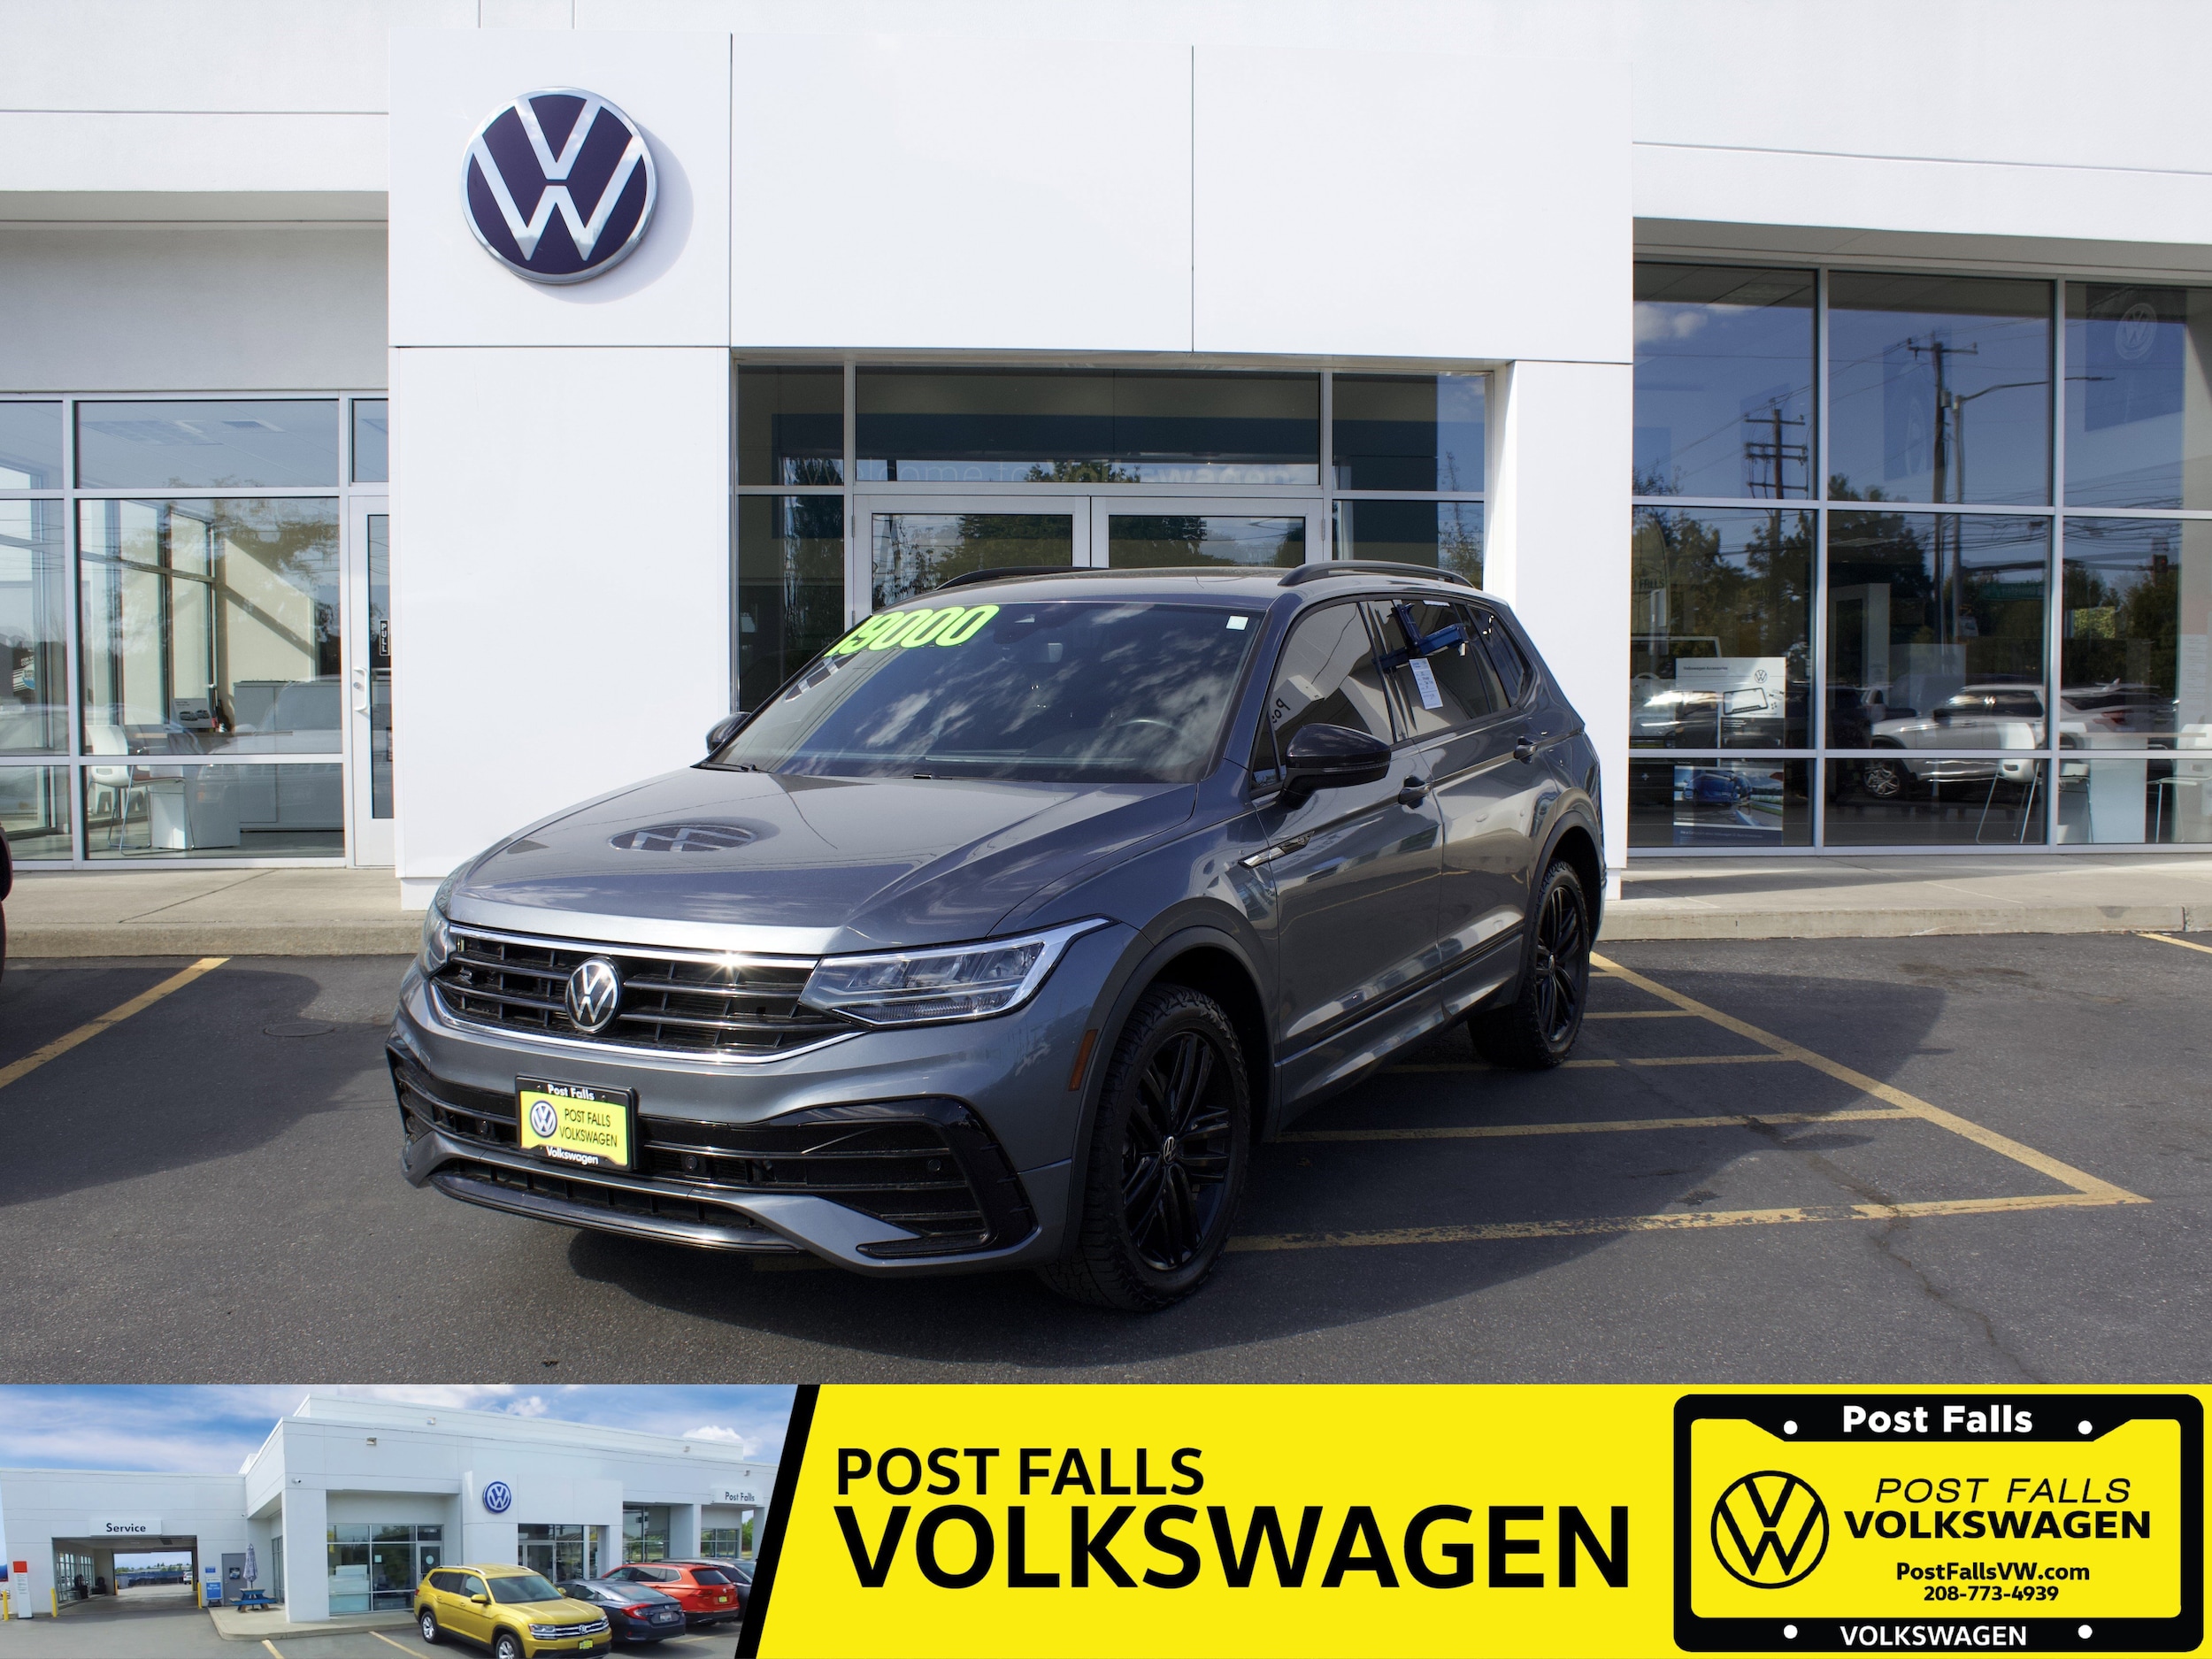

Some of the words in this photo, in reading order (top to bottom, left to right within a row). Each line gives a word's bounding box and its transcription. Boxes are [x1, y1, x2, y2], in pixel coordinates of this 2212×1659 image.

[547, 1084, 569, 1096] Post
[570, 1087, 595, 1101] Falls
[565, 1108, 585, 1123] POST
[588, 1112, 611, 1127] FALLS
[559, 1125, 618, 1147] VOLKSWAGEN
[546, 1146, 599, 1165] Volkswagen
